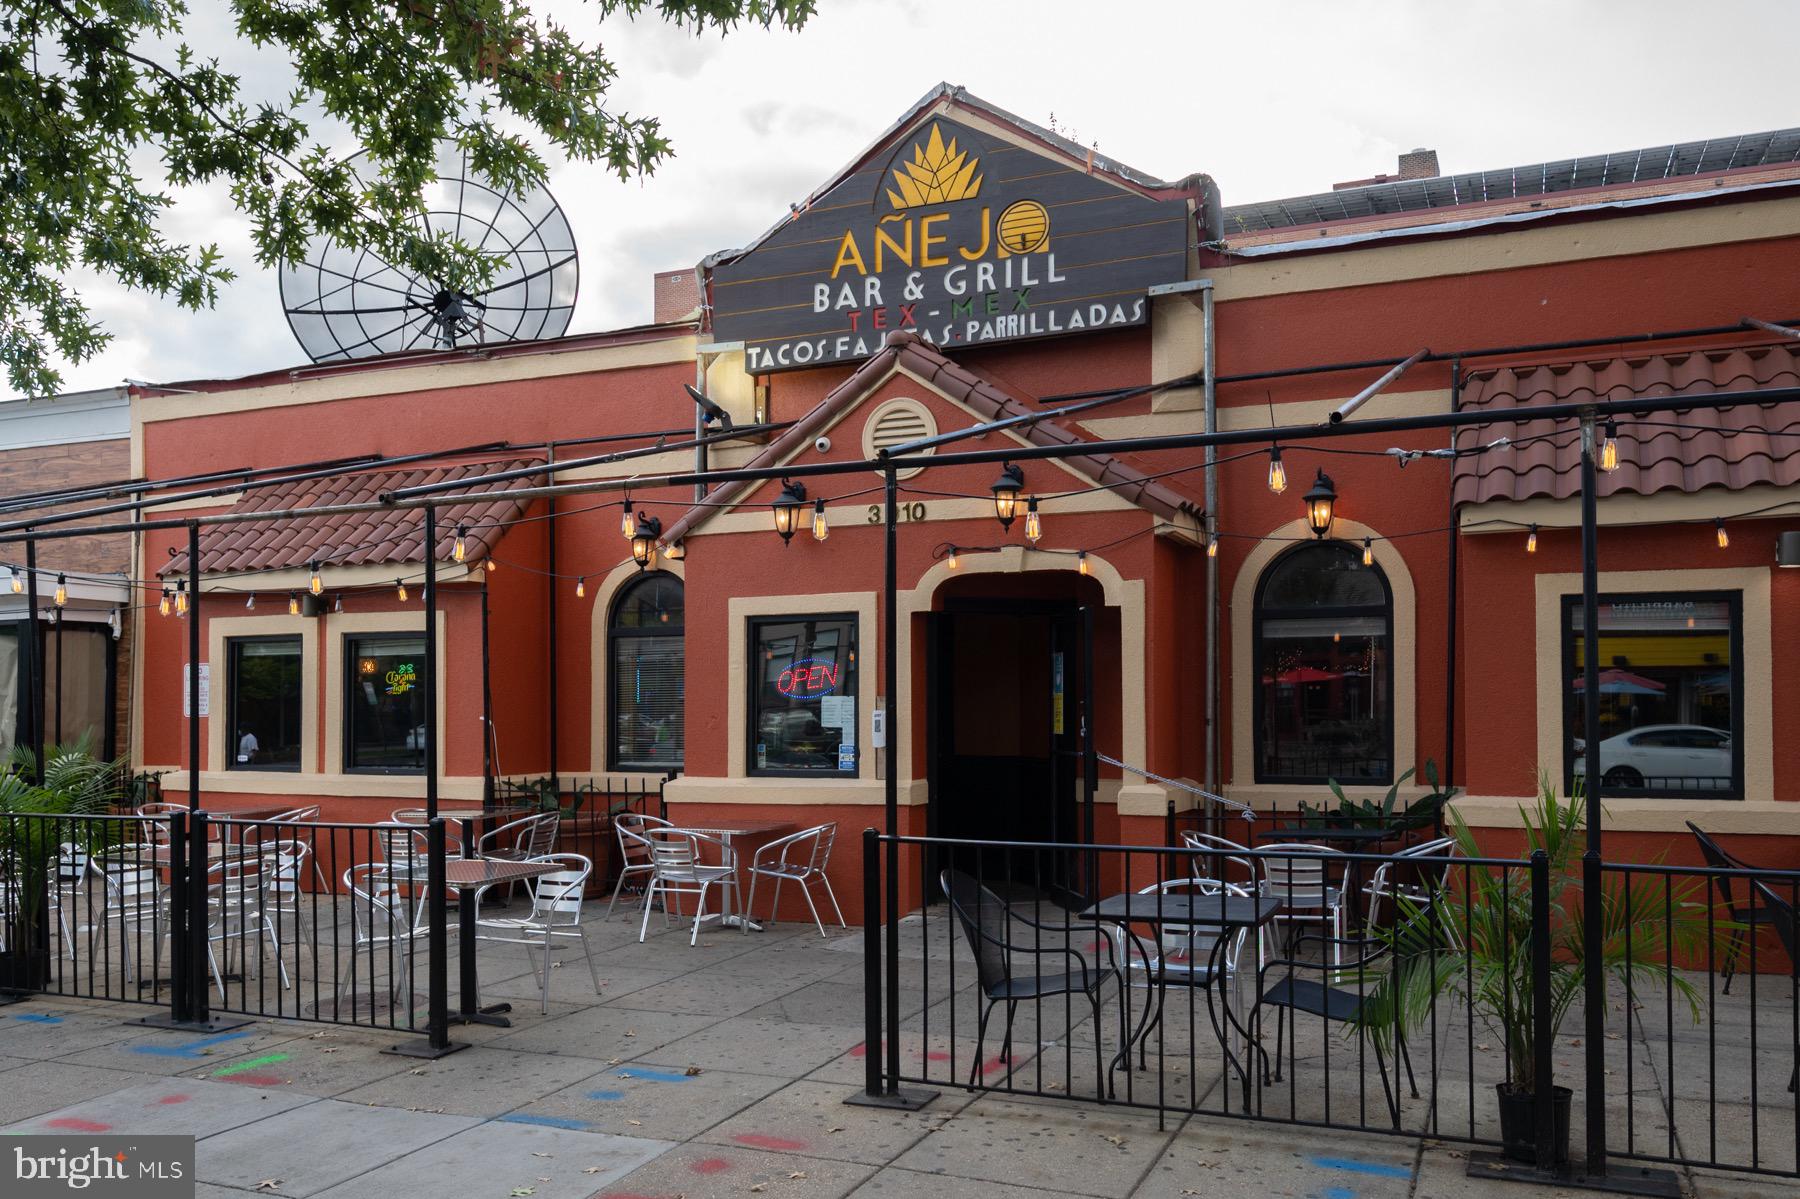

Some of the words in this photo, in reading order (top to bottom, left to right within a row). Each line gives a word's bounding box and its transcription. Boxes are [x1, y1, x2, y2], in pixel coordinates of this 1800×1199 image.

[831, 199, 1051, 279] AÑEJO
[813, 276, 884, 313] BAR
[903, 270, 925, 301] &
[943, 253, 1066, 296] GRILL
[747, 339, 827, 369] TACOS
[835, 324, 953, 358] FAJAS
[966, 299, 1144, 342] PARRILLADAS
[867, 502, 927, 524] 310
[777, 663, 838, 693] OPEN
